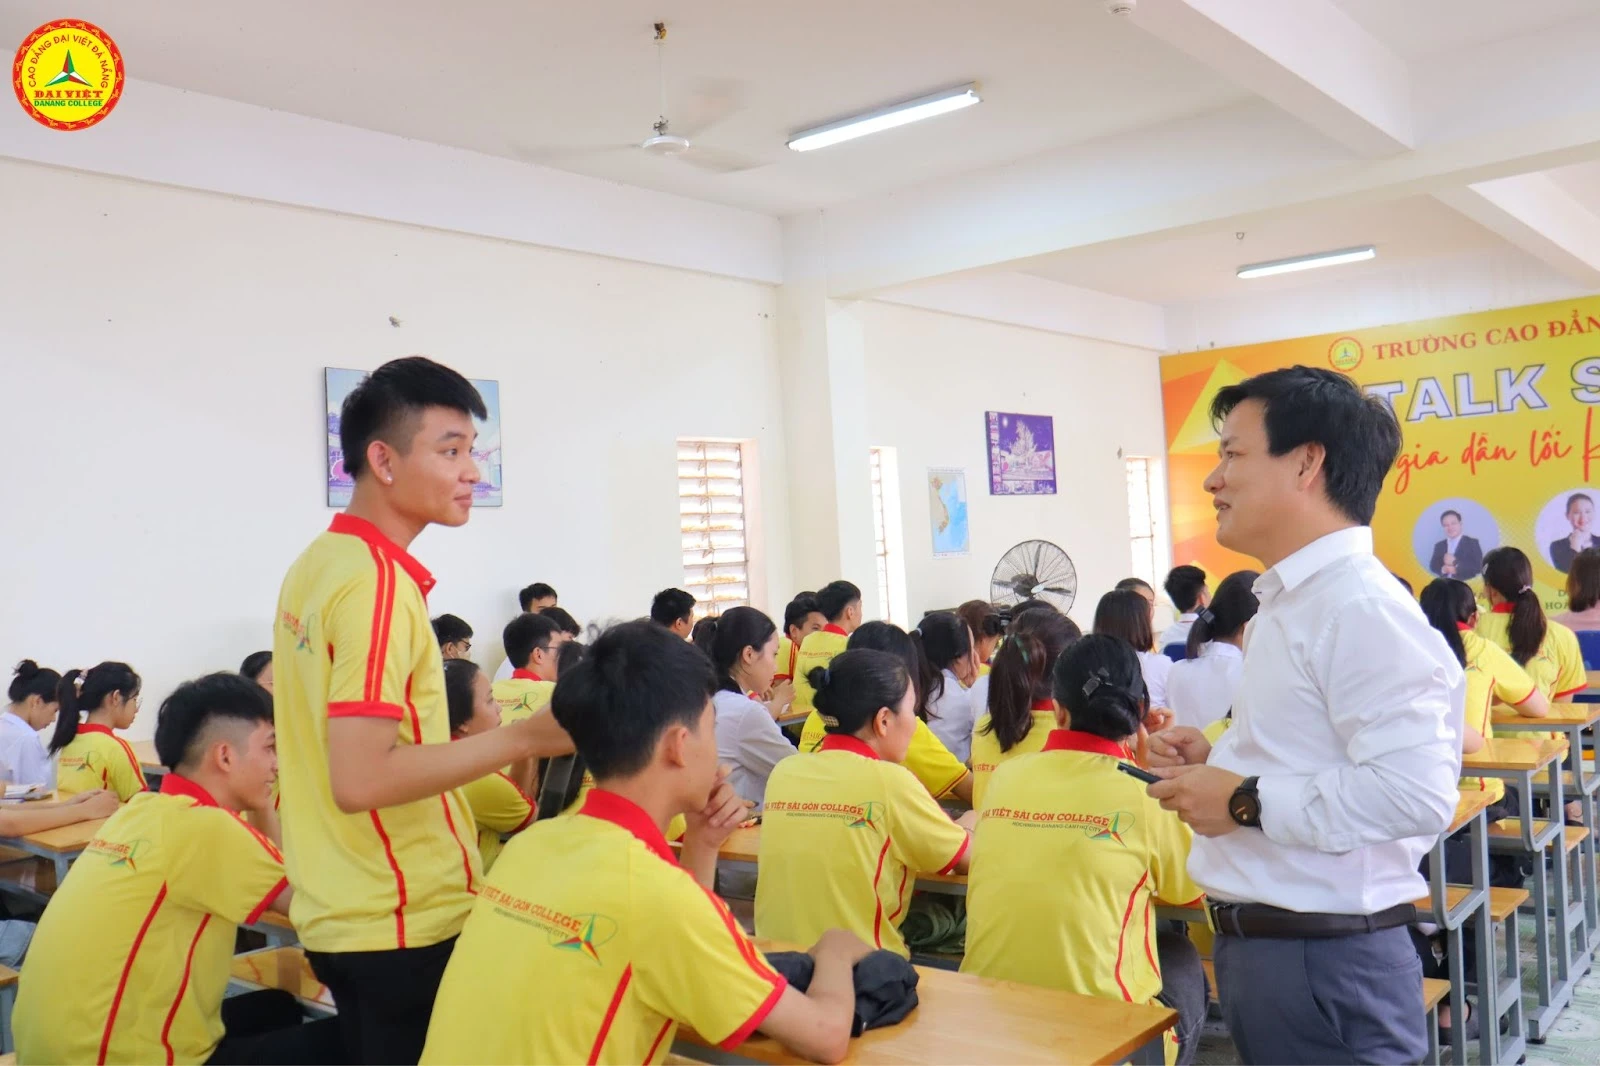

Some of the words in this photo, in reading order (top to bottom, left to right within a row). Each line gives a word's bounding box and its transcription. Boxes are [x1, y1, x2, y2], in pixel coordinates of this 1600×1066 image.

[1372, 332, 1477, 361] TRƯỜNG
[1485, 323, 1539, 346] CAO
[1362, 363, 1549, 423] TALK
[1394, 443, 1449, 495] gia
[820, 803, 864, 816] COLLEGE
[1056, 813, 1110, 827] COLLEGE
[530, 903, 582, 933] COLLEGE
